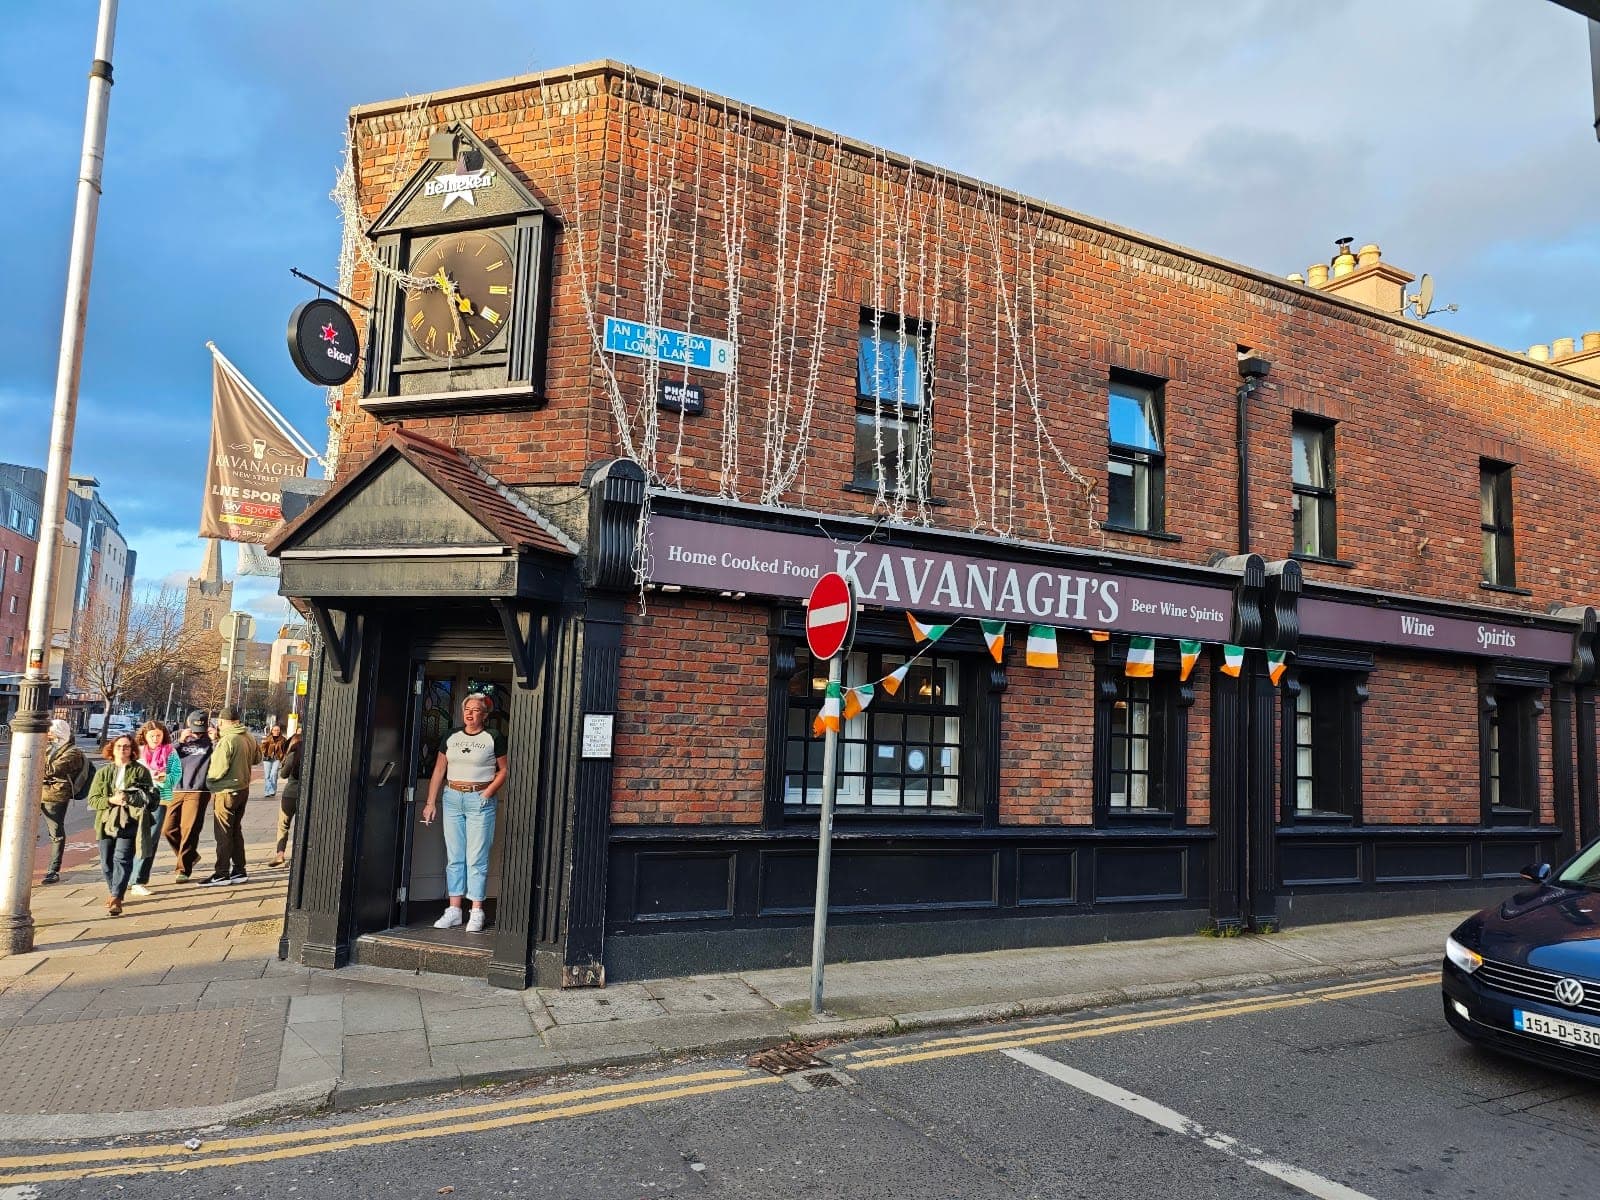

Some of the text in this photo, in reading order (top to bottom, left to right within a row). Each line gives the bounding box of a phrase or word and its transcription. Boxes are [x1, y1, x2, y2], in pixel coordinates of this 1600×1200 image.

[424, 174, 493, 196] Heineken
[613, 323, 631, 337] AN
[676, 335, 707, 352] FADA
[663, 346, 696, 363] LANE
[718, 348, 726, 363] 8
[214, 454, 304, 478] KAVANAGHS
[232, 470, 251, 479] NEW
[212, 484, 281, 503] LIVE SPOR
[668, 545, 820, 579] Home Cooked Food
[833, 548, 1120, 624] KAVANAGH'S
[1131, 598, 1224, 623] Beer Wine Spirits
[1400, 615, 1516, 649] Wine Spirits
